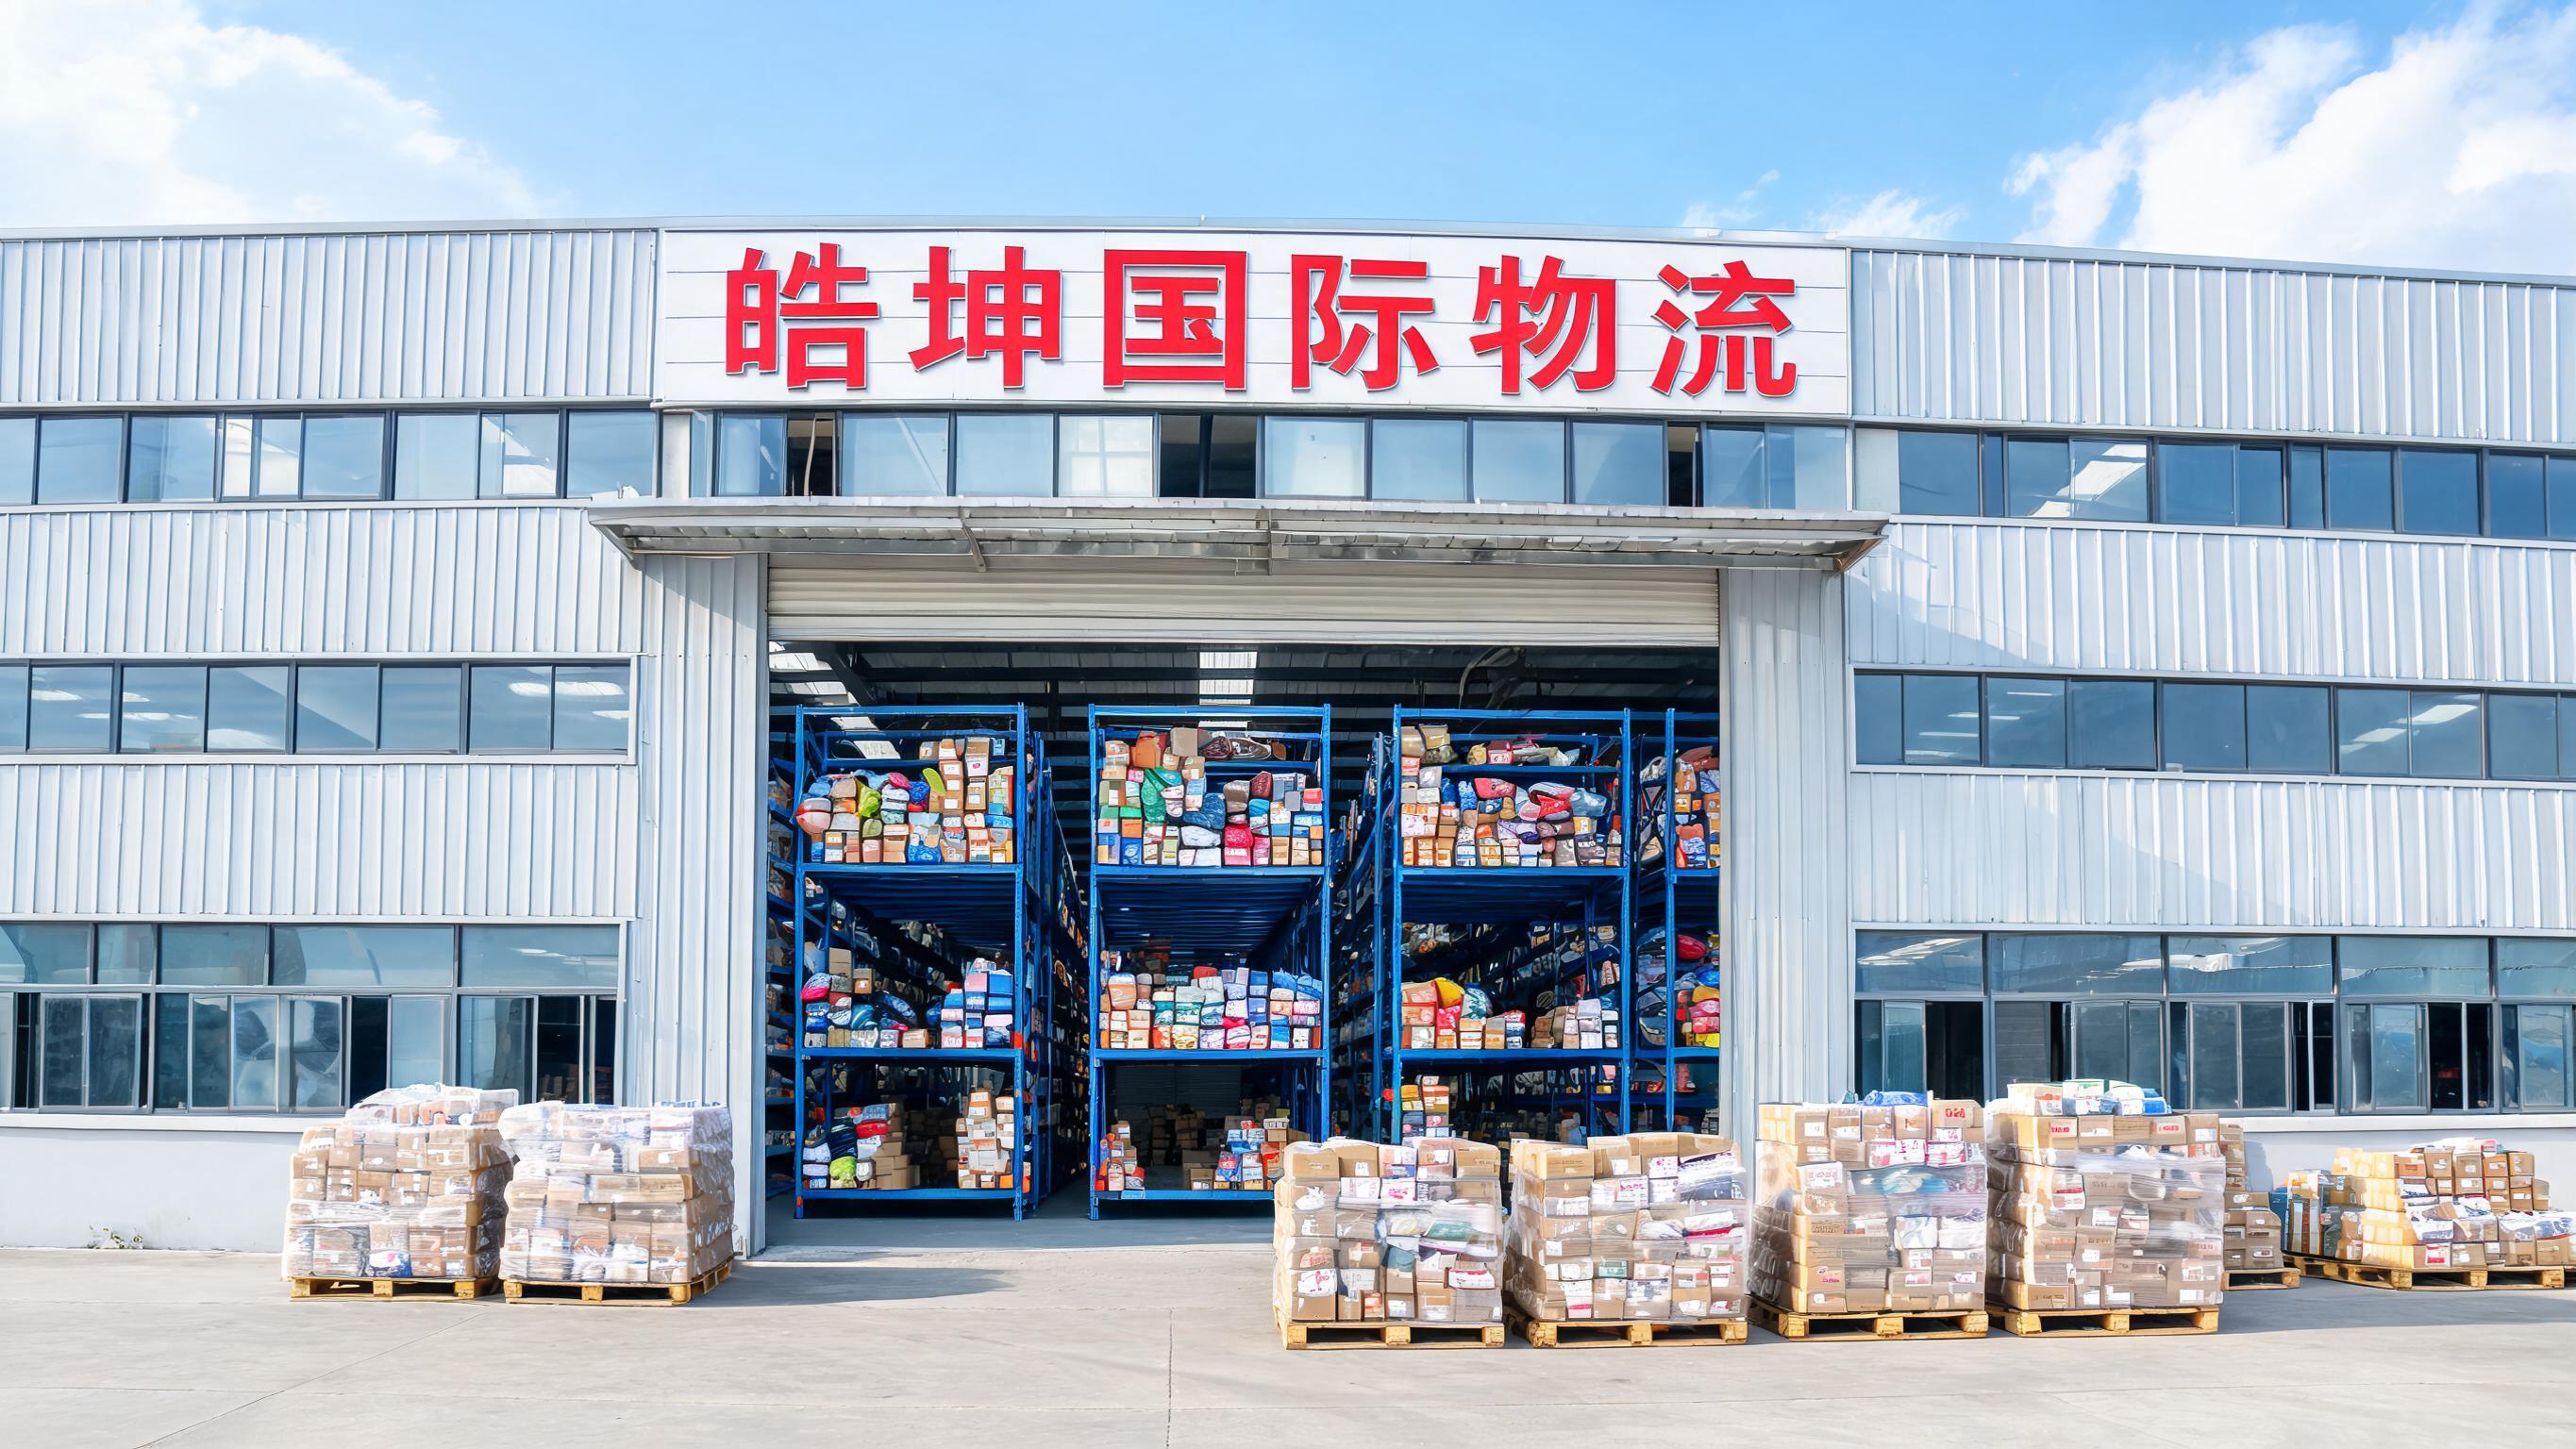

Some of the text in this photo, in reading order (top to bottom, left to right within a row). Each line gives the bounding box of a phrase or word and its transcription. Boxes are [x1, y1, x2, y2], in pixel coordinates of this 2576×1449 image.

[726, 242, 1798, 397] 皓坤国际物流
